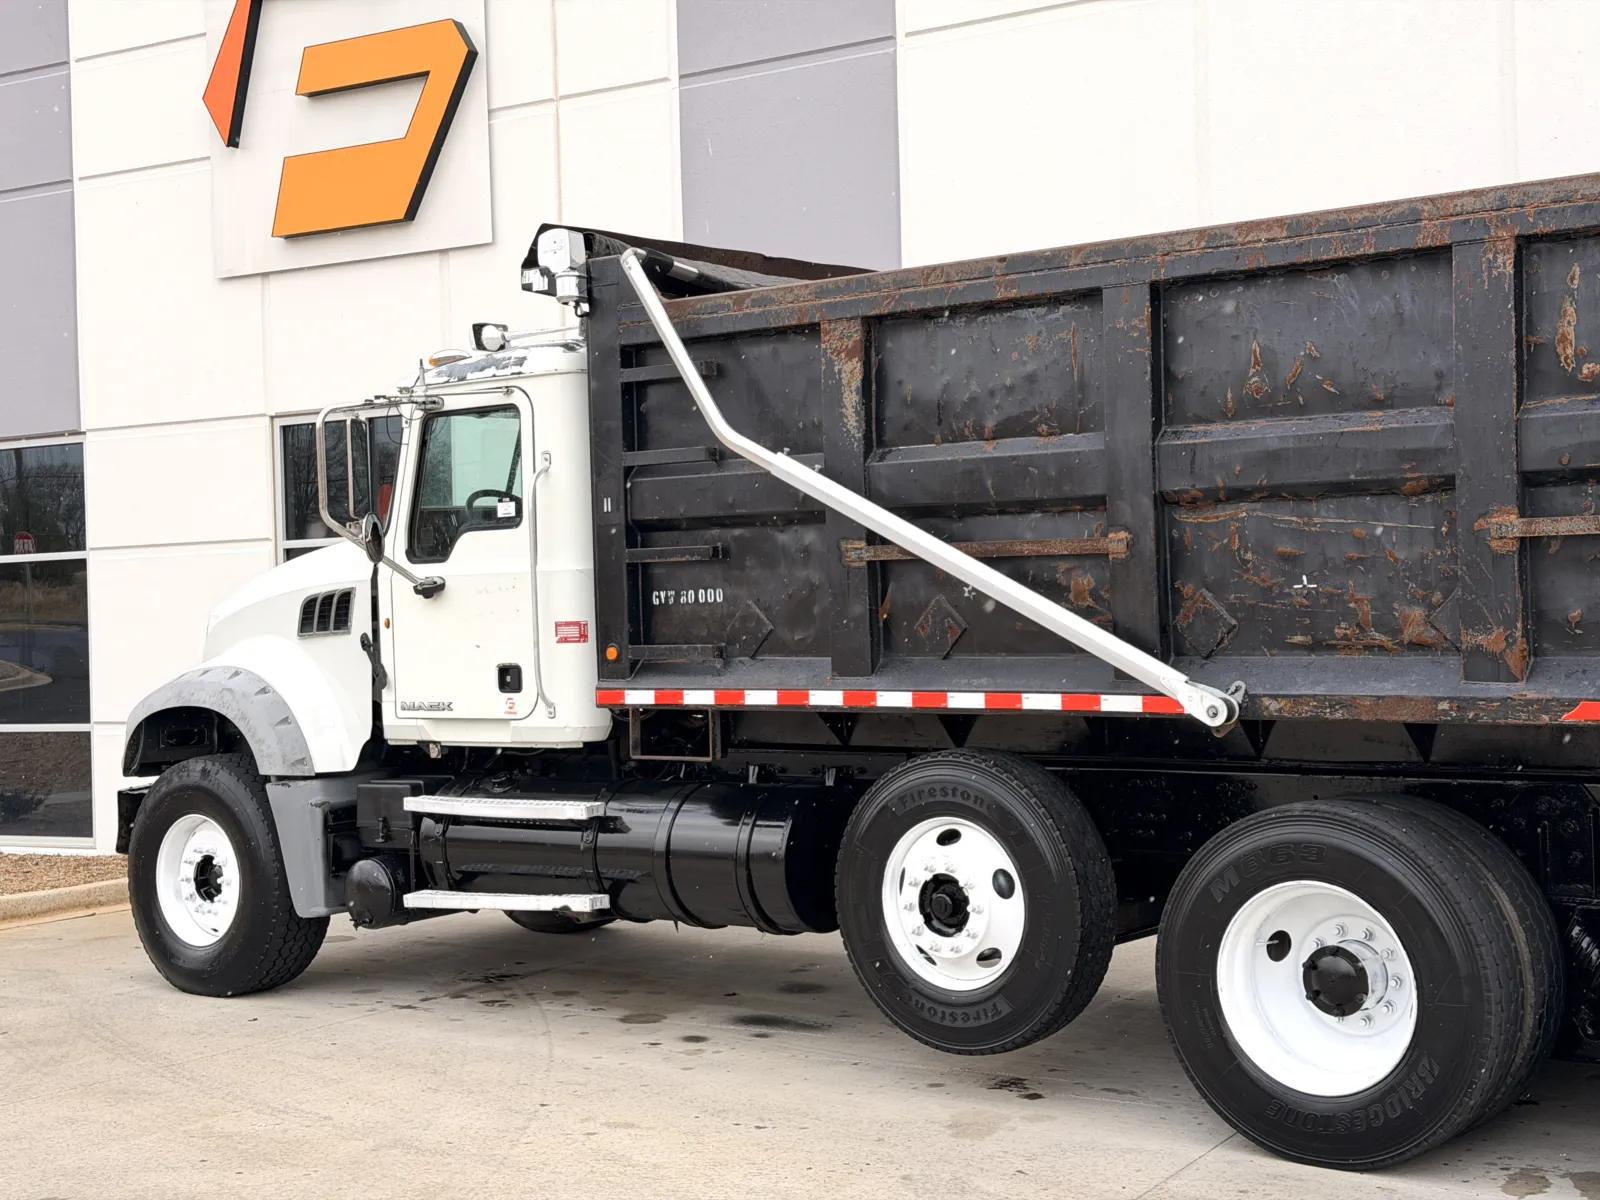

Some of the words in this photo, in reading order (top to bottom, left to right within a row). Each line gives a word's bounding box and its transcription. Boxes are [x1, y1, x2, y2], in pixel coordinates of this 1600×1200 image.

[400, 701, 454, 711] MACK
[897, 785, 993, 811] Firestone
[905, 992, 1003, 1022] Firestone
[1263, 1051, 1440, 1134] BRIDGESTONE
